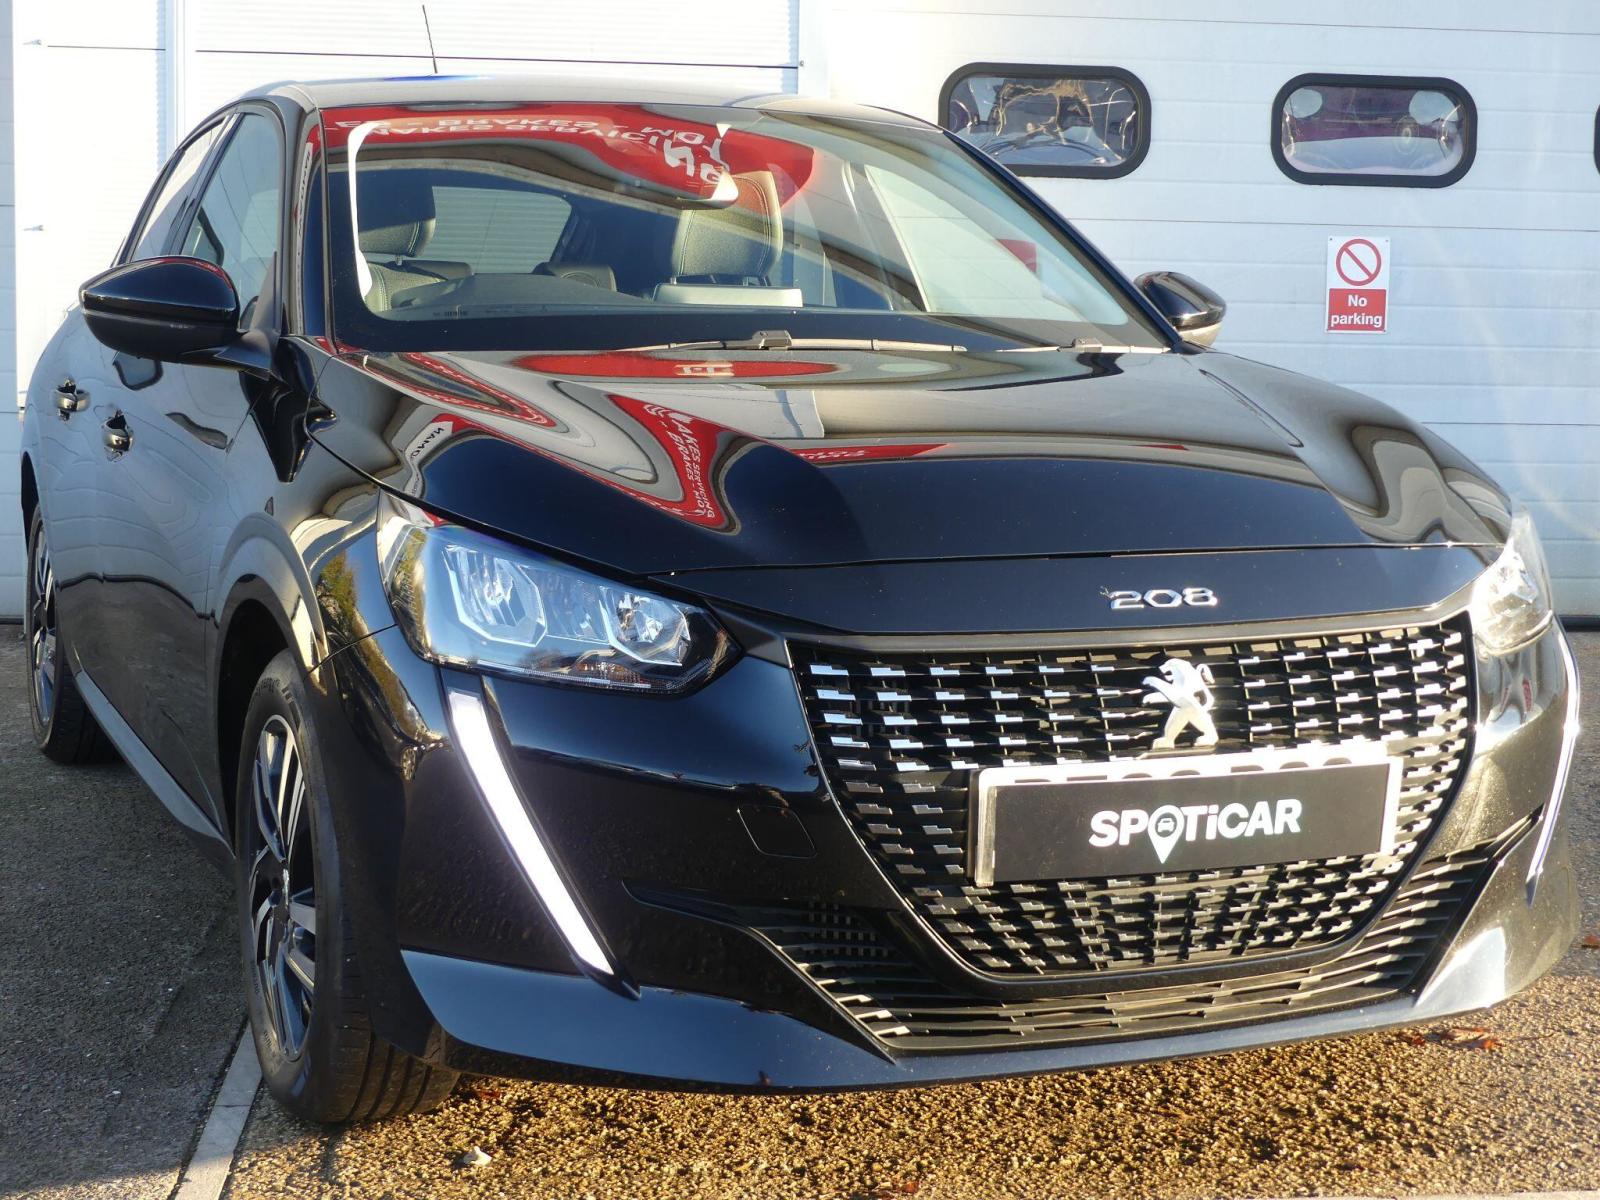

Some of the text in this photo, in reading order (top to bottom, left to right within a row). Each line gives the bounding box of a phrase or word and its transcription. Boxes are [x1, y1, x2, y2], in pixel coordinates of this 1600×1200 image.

[1348, 295, 1367, 307] No
[1331, 313, 1382, 328] parking
[1108, 587, 1218, 609] 208
